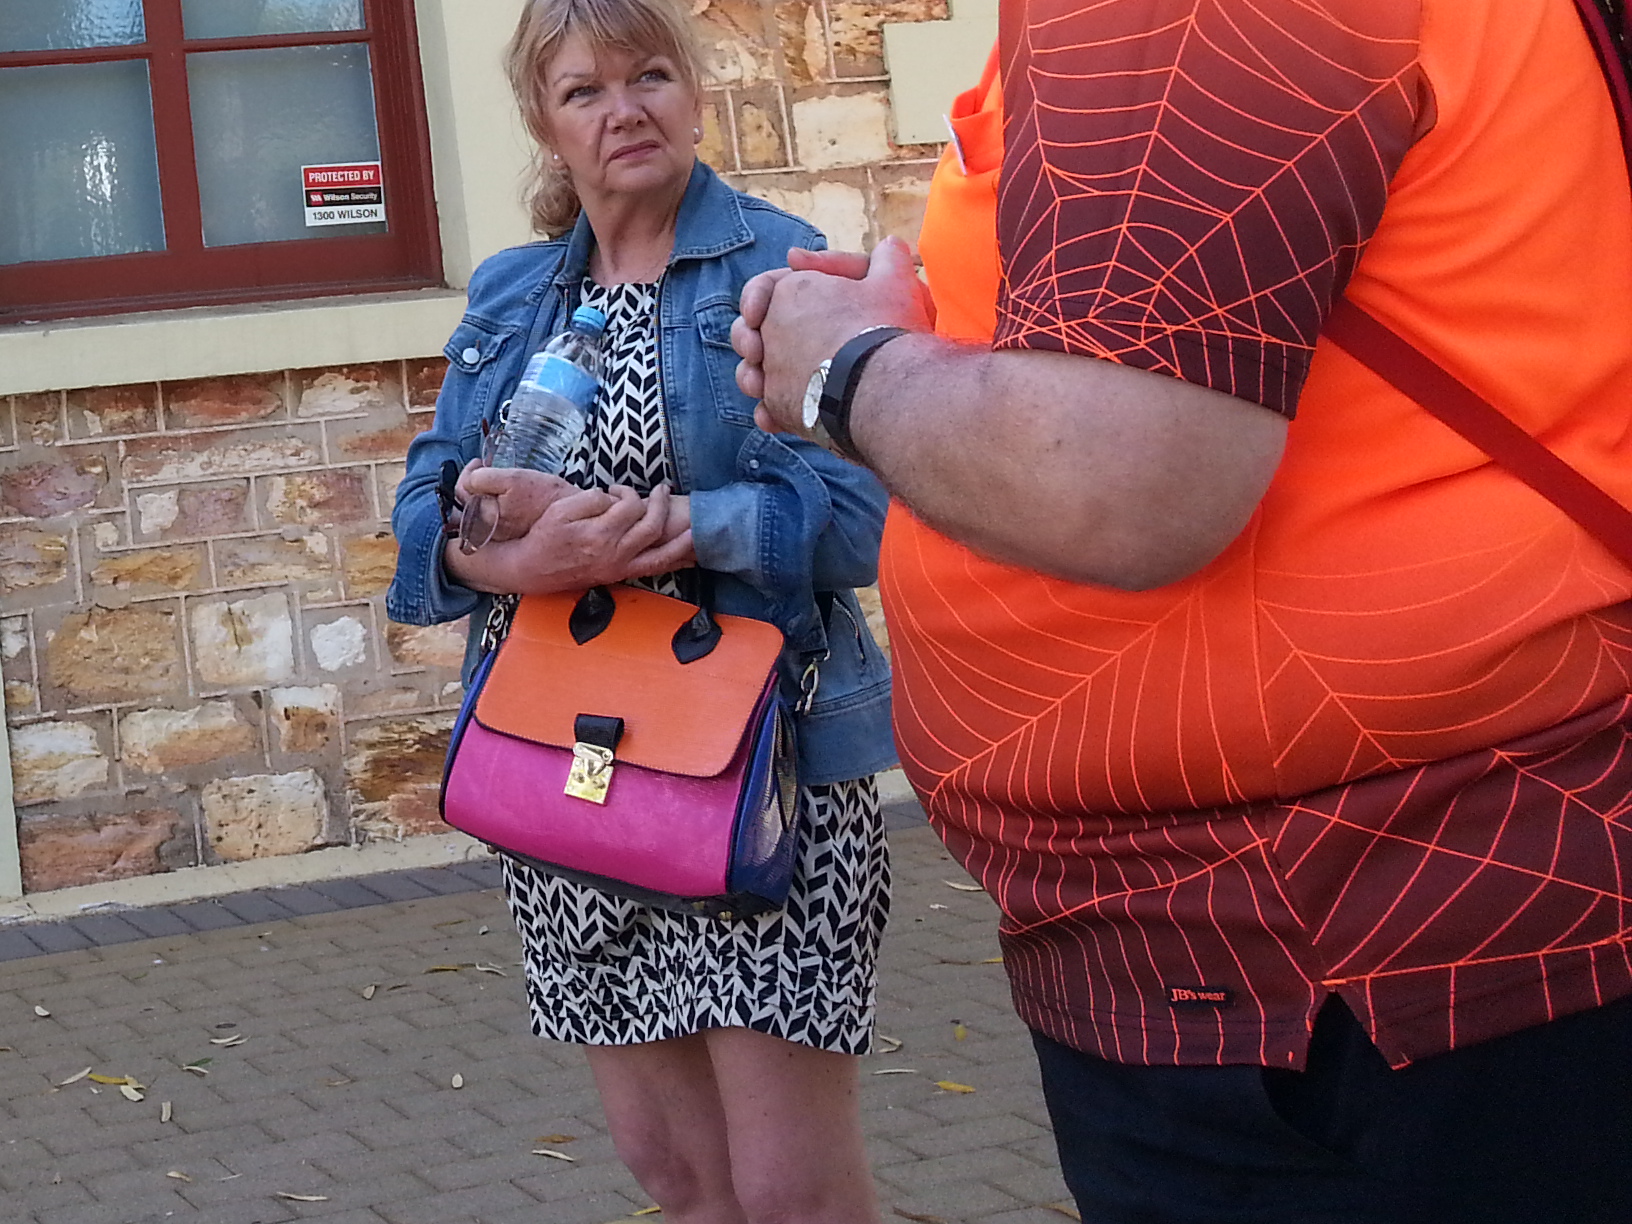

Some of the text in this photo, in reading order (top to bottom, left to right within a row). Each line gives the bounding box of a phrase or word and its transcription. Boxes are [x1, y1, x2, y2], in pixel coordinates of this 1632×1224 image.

[308, 170, 374, 182] PROTECTED BY
[323, 192, 377, 201] Wilson Security
[312, 209, 377, 220] 1300 WILSON
[1171, 988, 1225, 1002] JB's wear
